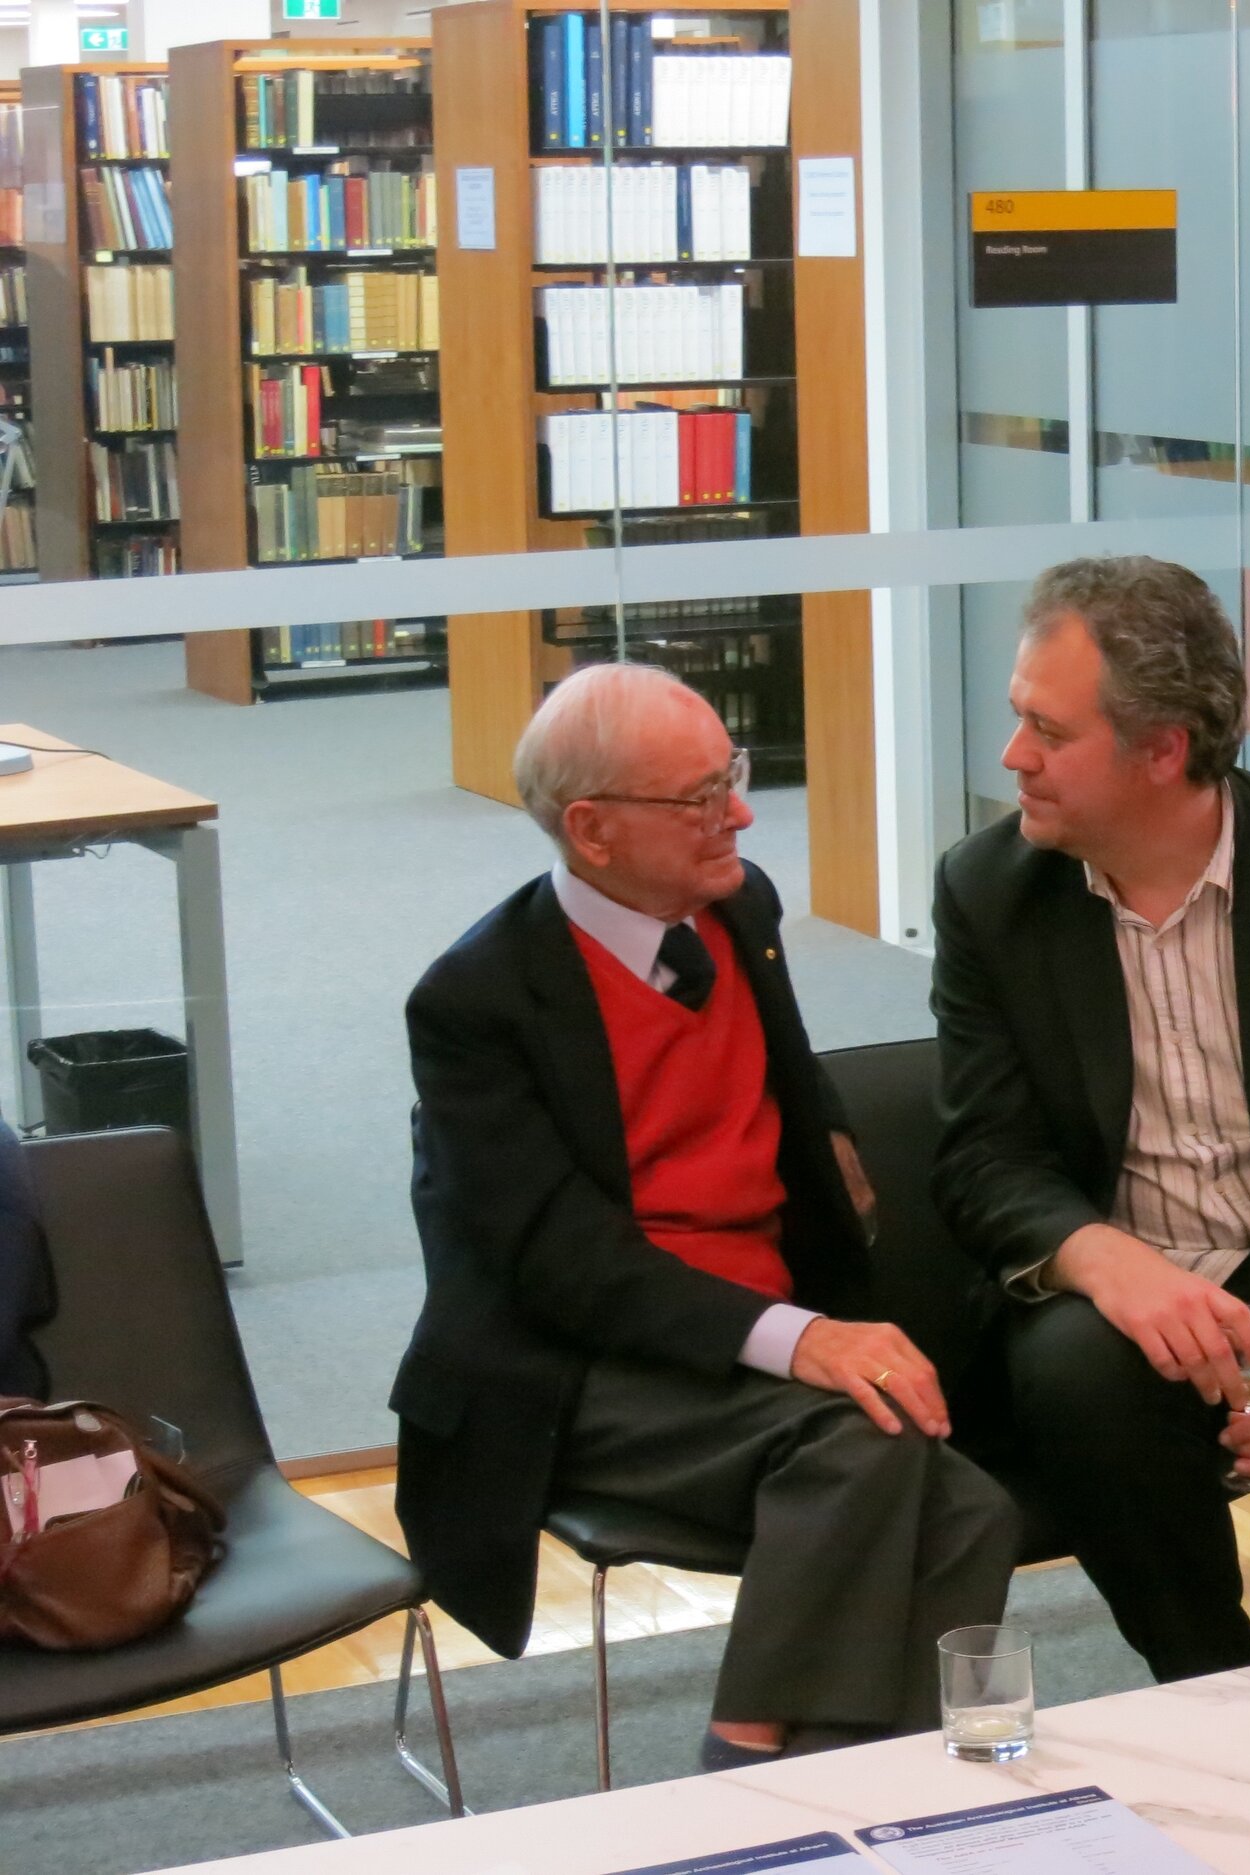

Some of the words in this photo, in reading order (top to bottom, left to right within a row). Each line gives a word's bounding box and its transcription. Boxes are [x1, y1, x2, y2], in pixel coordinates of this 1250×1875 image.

[985, 199, 1015, 214] 480
[985, 245, 1021, 256] Reading
[1022, 245, 1048, 254] Room
